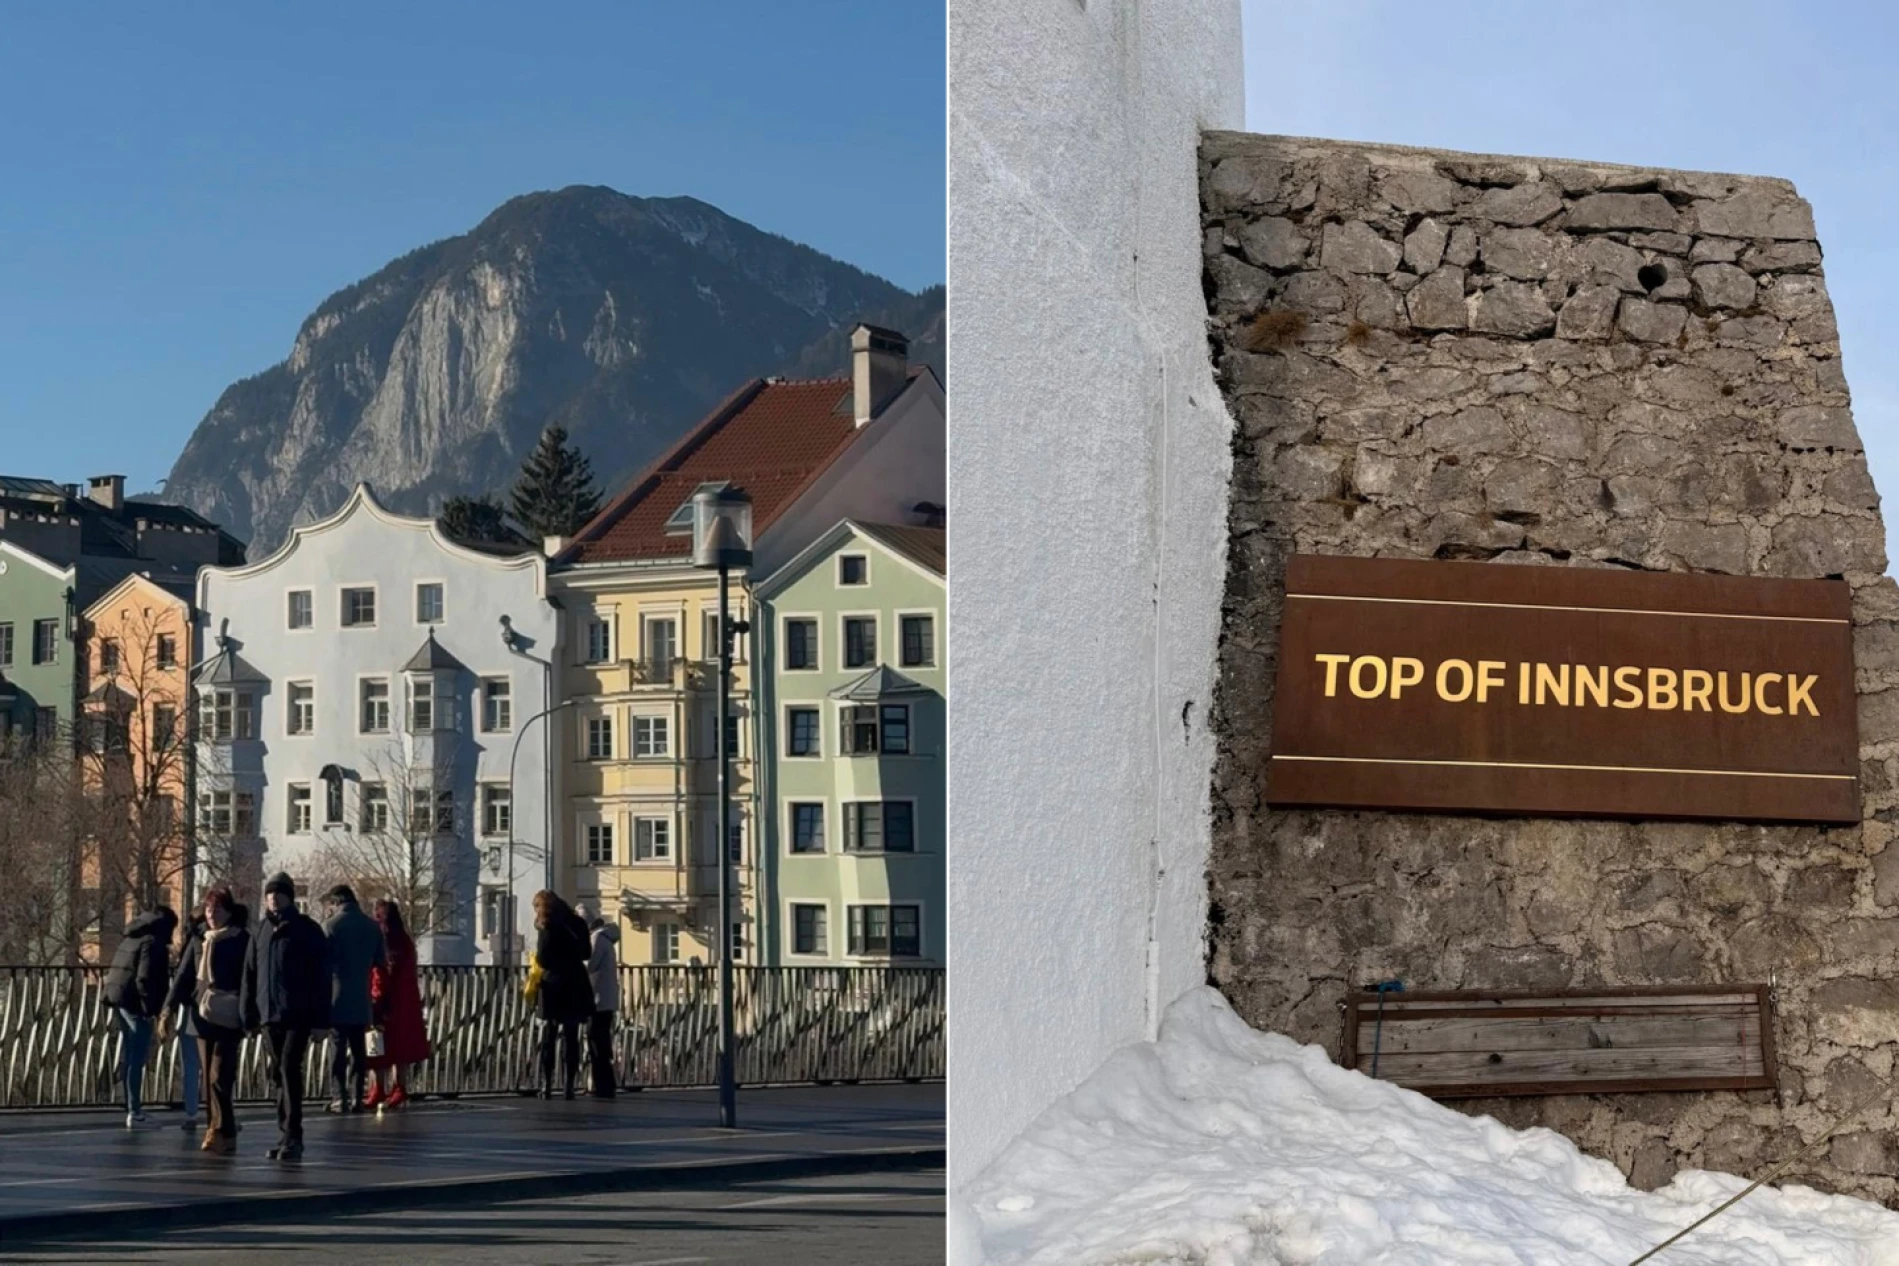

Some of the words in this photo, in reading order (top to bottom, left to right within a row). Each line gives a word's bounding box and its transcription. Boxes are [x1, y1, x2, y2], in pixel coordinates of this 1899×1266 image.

[1315, 653, 1424, 699] TOP
[1435, 658, 1506, 704] OF
[1518, 662, 1821, 717] INNSBRUCK
